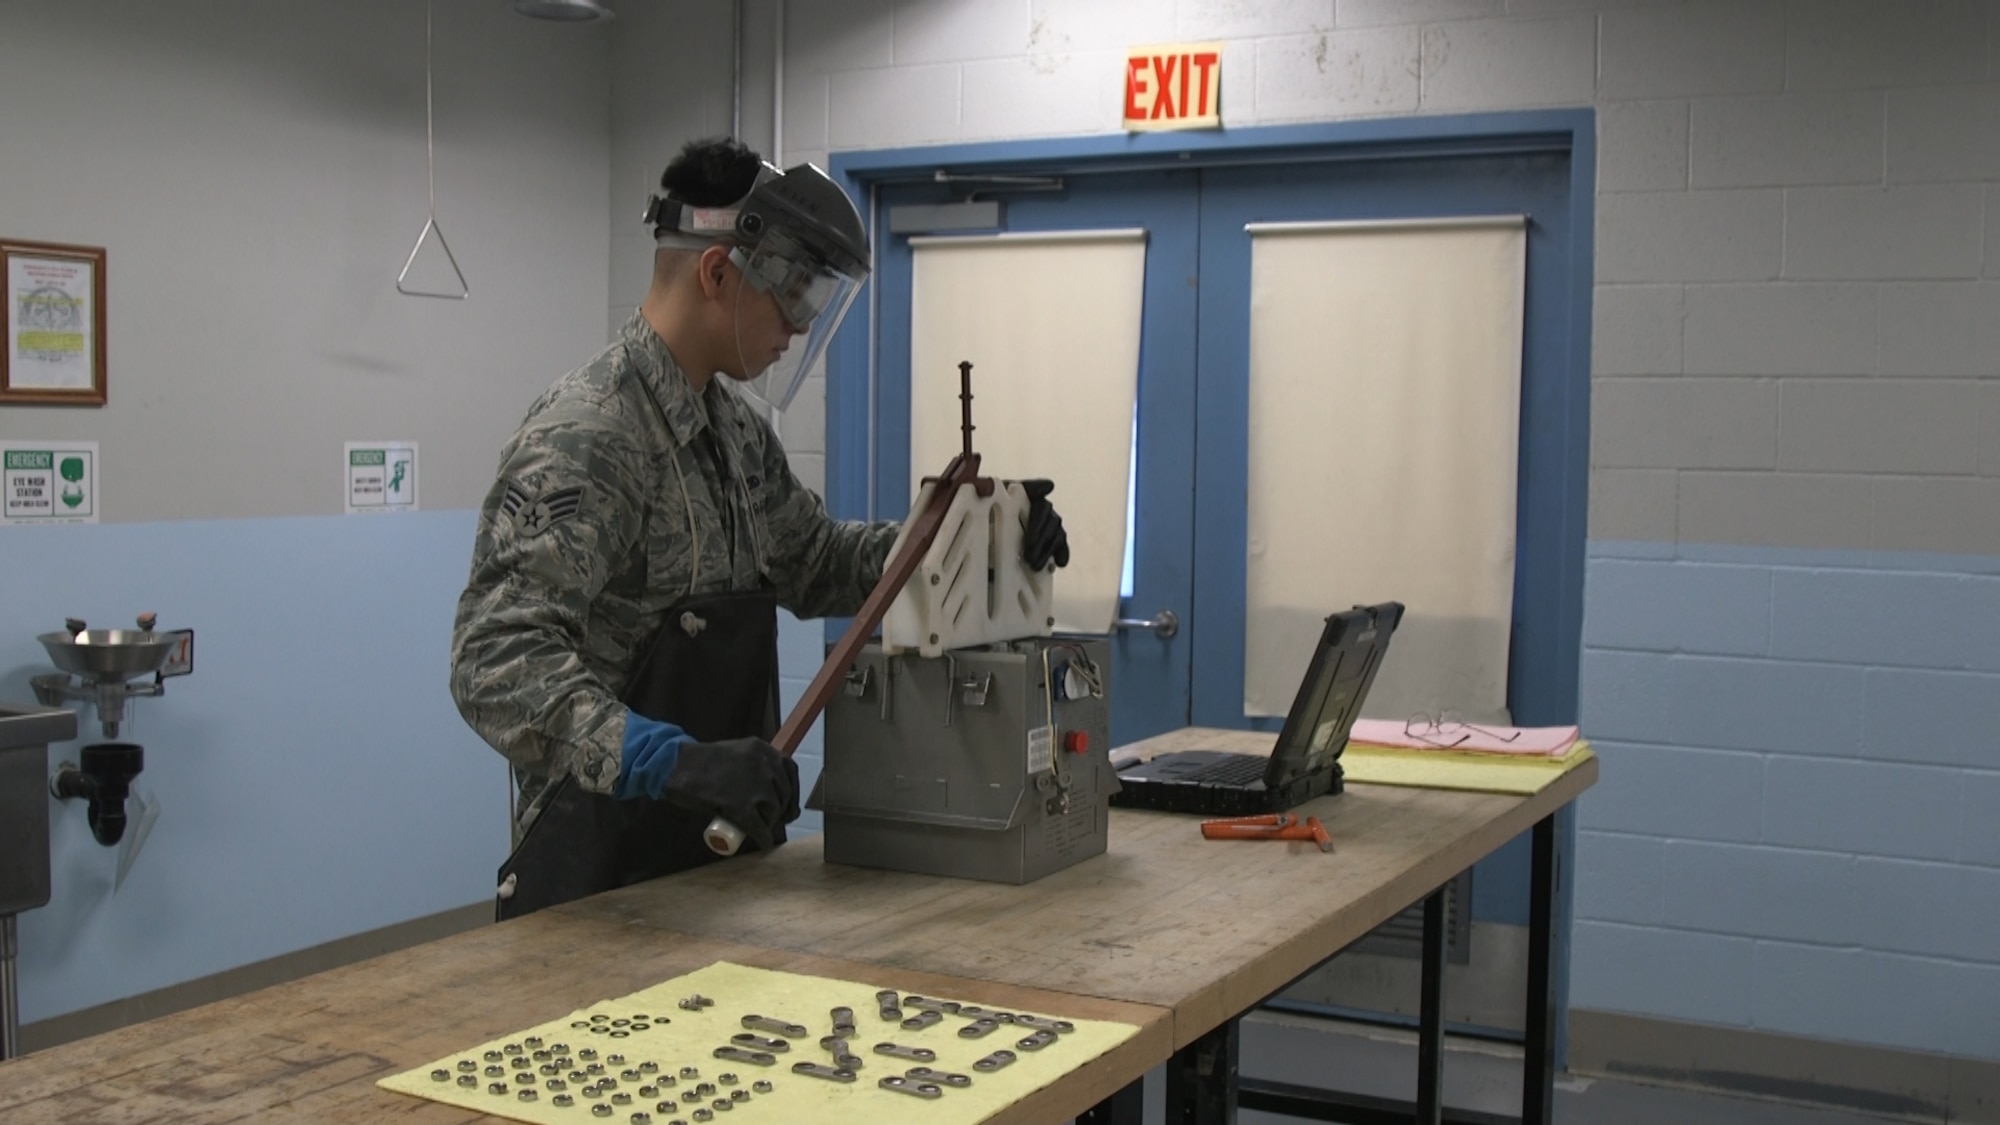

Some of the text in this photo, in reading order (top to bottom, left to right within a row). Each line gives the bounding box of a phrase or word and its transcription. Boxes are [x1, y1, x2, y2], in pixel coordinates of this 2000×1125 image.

[1125, 52, 1218, 120] EXIT
[7, 451, 51, 468] EMERGENCY
[13, 477, 46, 486] EYE WASH
[16, 488, 43, 497] STATION
